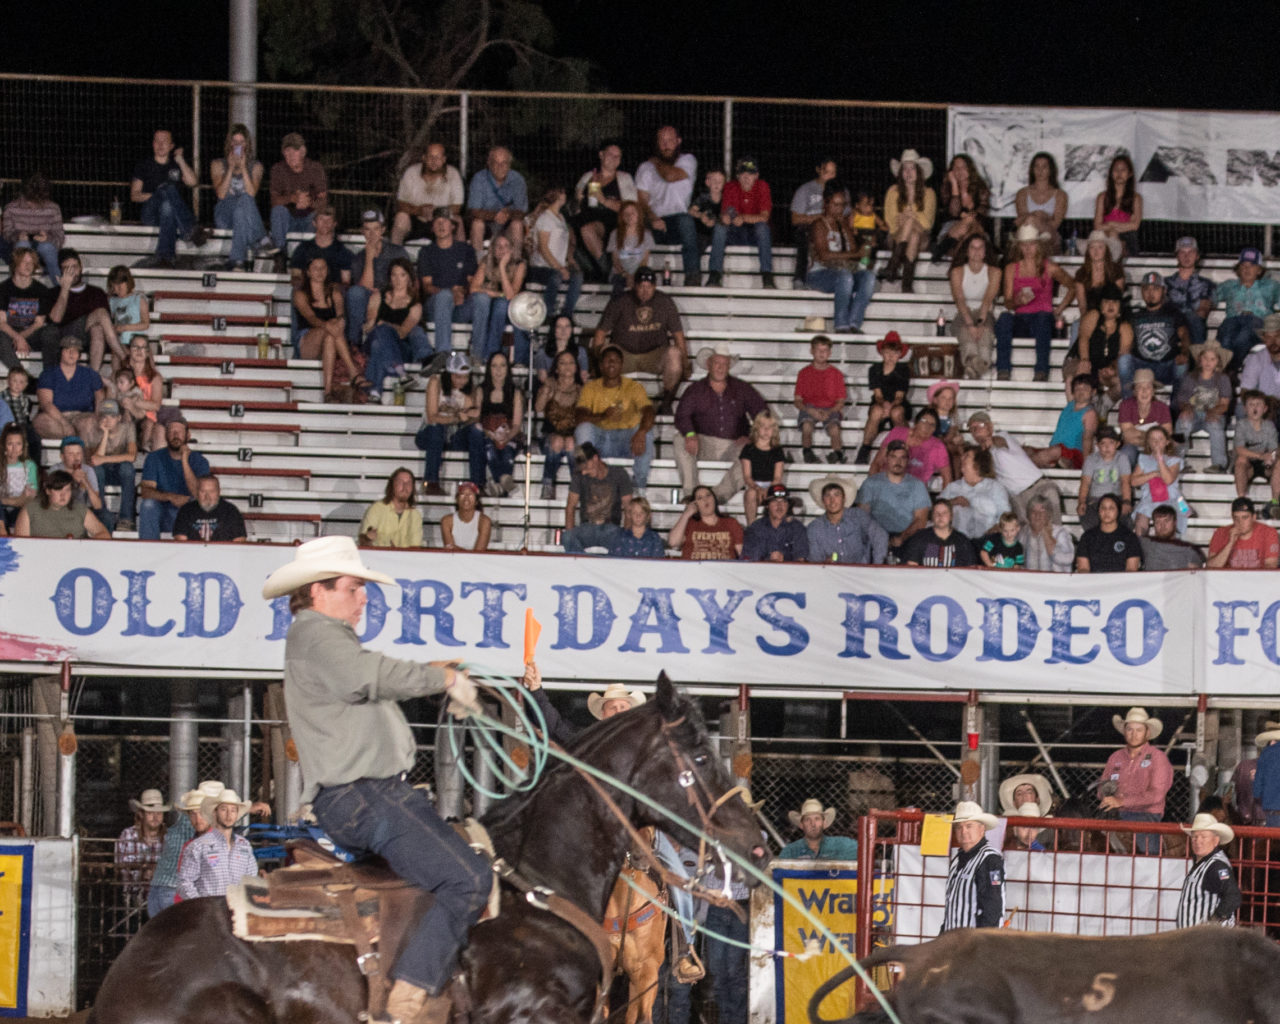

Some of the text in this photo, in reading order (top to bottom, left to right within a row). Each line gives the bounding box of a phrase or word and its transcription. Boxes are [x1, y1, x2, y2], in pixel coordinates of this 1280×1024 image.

[222, 361, 235, 373] 14
[230, 404, 244, 416] 13
[239, 449, 252, 461] 12
[49, 567, 245, 638] OLD
[551, 584, 810, 657] DAYS
[838, 591, 1169, 666] RODEO
[1082, 972, 1118, 1011] 5
